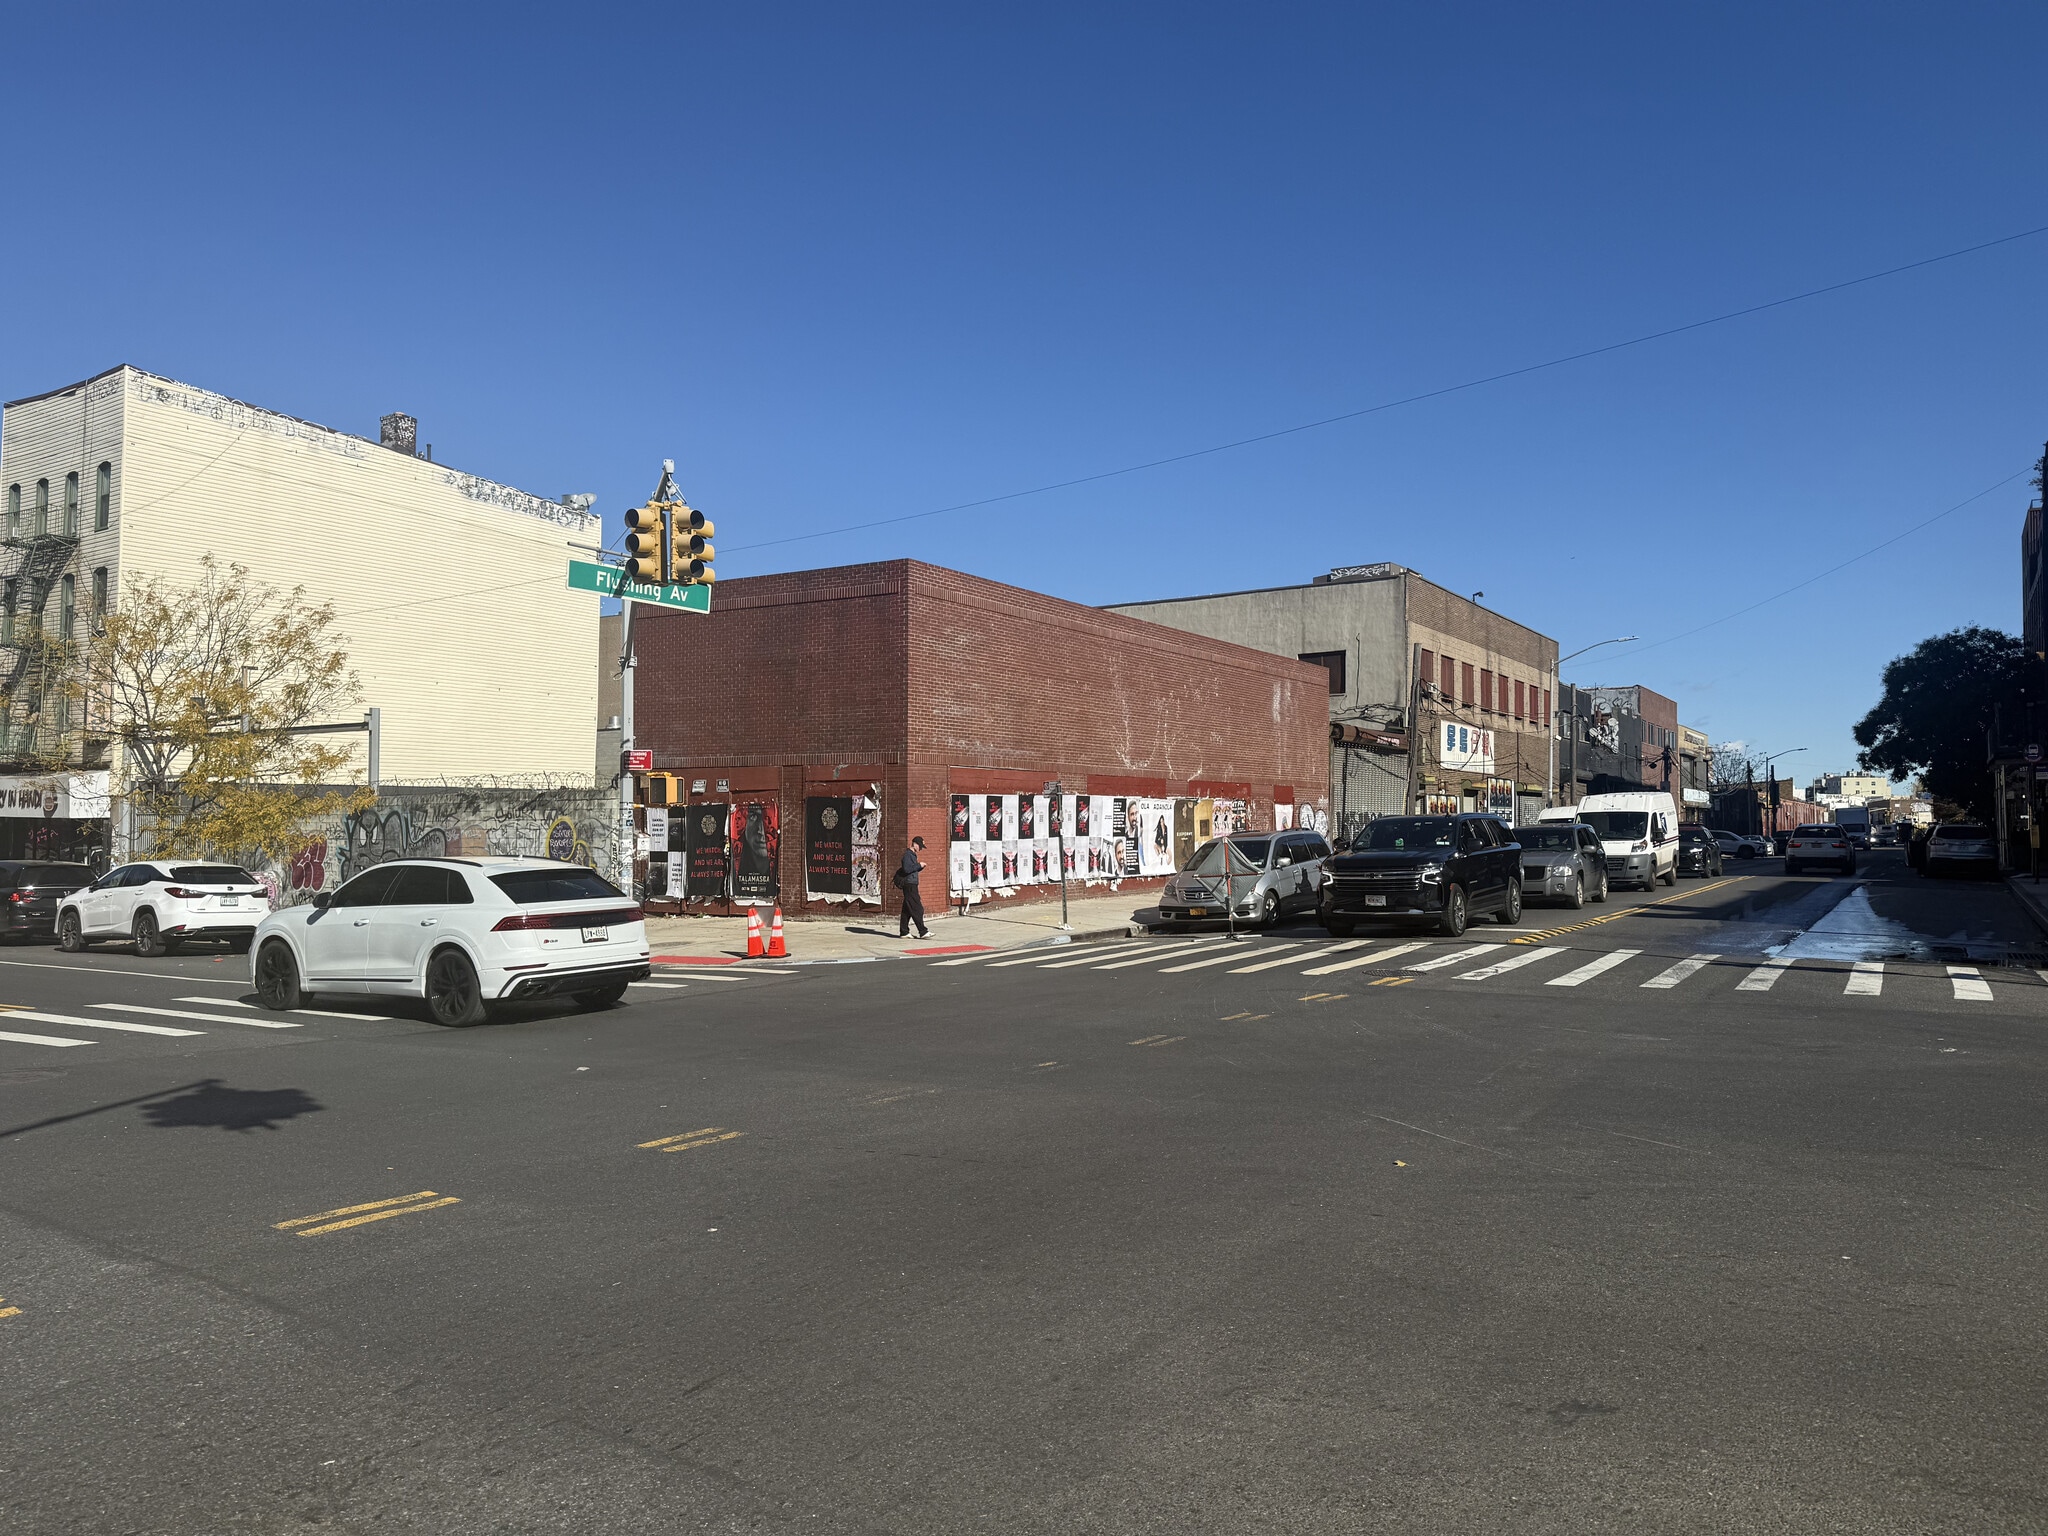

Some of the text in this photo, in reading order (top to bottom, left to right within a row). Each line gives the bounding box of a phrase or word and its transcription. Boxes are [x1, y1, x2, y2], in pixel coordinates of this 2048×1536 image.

[596, 570, 689, 602] Flushing Av
[814, 841, 823, 849] WE
[813, 853, 846, 862] AND WE ARE
[808, 866, 830, 874] ALWAYS
